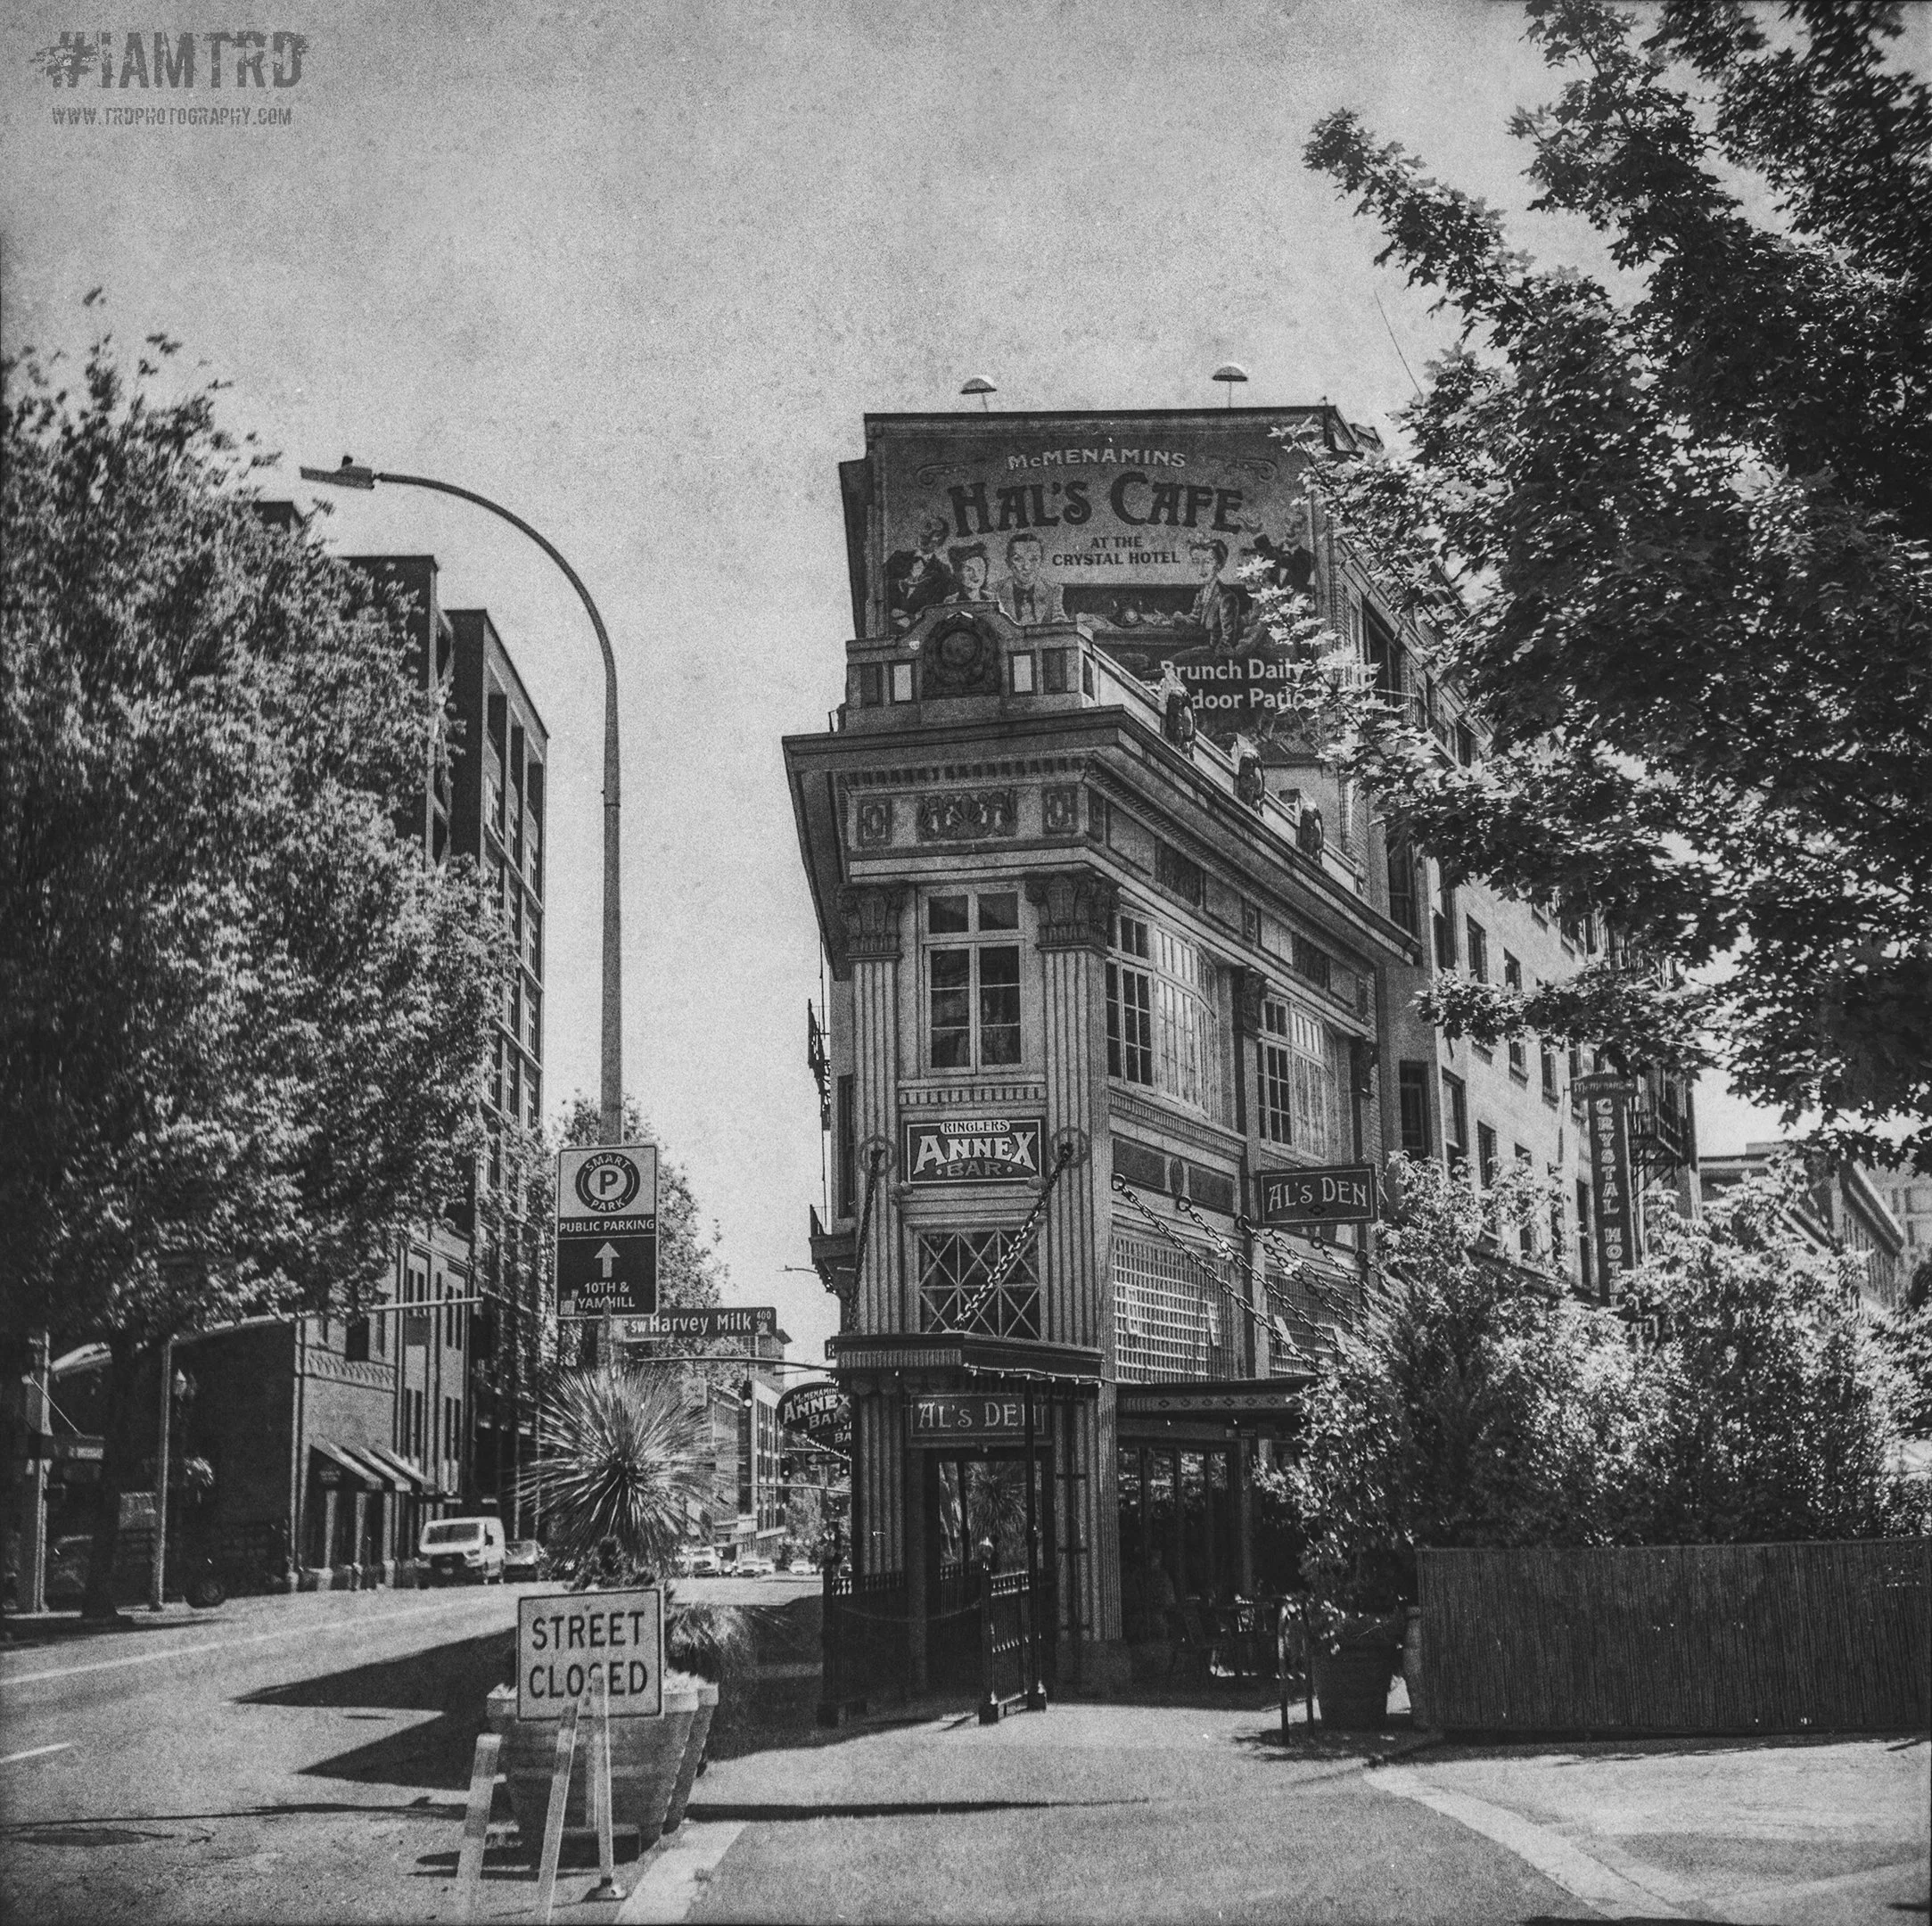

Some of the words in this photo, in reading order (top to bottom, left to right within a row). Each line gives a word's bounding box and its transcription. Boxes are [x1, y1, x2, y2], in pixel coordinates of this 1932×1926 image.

[1007, 448, 1187, 471] McMENAMINS
[947, 480, 1093, 538] HAL'S
[1110, 471, 1245, 535] CAFE
[1090, 537, 1109, 549] AT
[1114, 536, 1143, 548] THE
[1052, 553, 1124, 567] CRYSTAL
[1129, 551, 1181, 565] HOTEL
[943, 1121, 1009, 1133] RINGLERS
[585, 1154, 632, 1172] SMART
[913, 1131, 1037, 1175] ANNEX
[1595, 1098, 1619, 1214] CRYSTAL
[946, 1160, 1002, 1177] BAR
[599, 1170, 619, 1196] P
[1320, 1176, 1368, 1207] DEN
[590, 1198, 626, 1212] PARK
[559, 1221, 600, 1232] PUBLIC
[603, 1219, 655, 1231] PARKING
[584, 1281, 616, 1294] 10TH
[620, 1280, 629, 1293] &
[578, 1296, 636, 1309] YAMHILL
[630, 1321, 646, 1333] SW
[650, 1314, 709, 1336] Harvey
[717, 1312, 752, 1332] Milk
[784, 1394, 851, 1427] ANNEX
[531, 1610, 645, 1650] STREET
